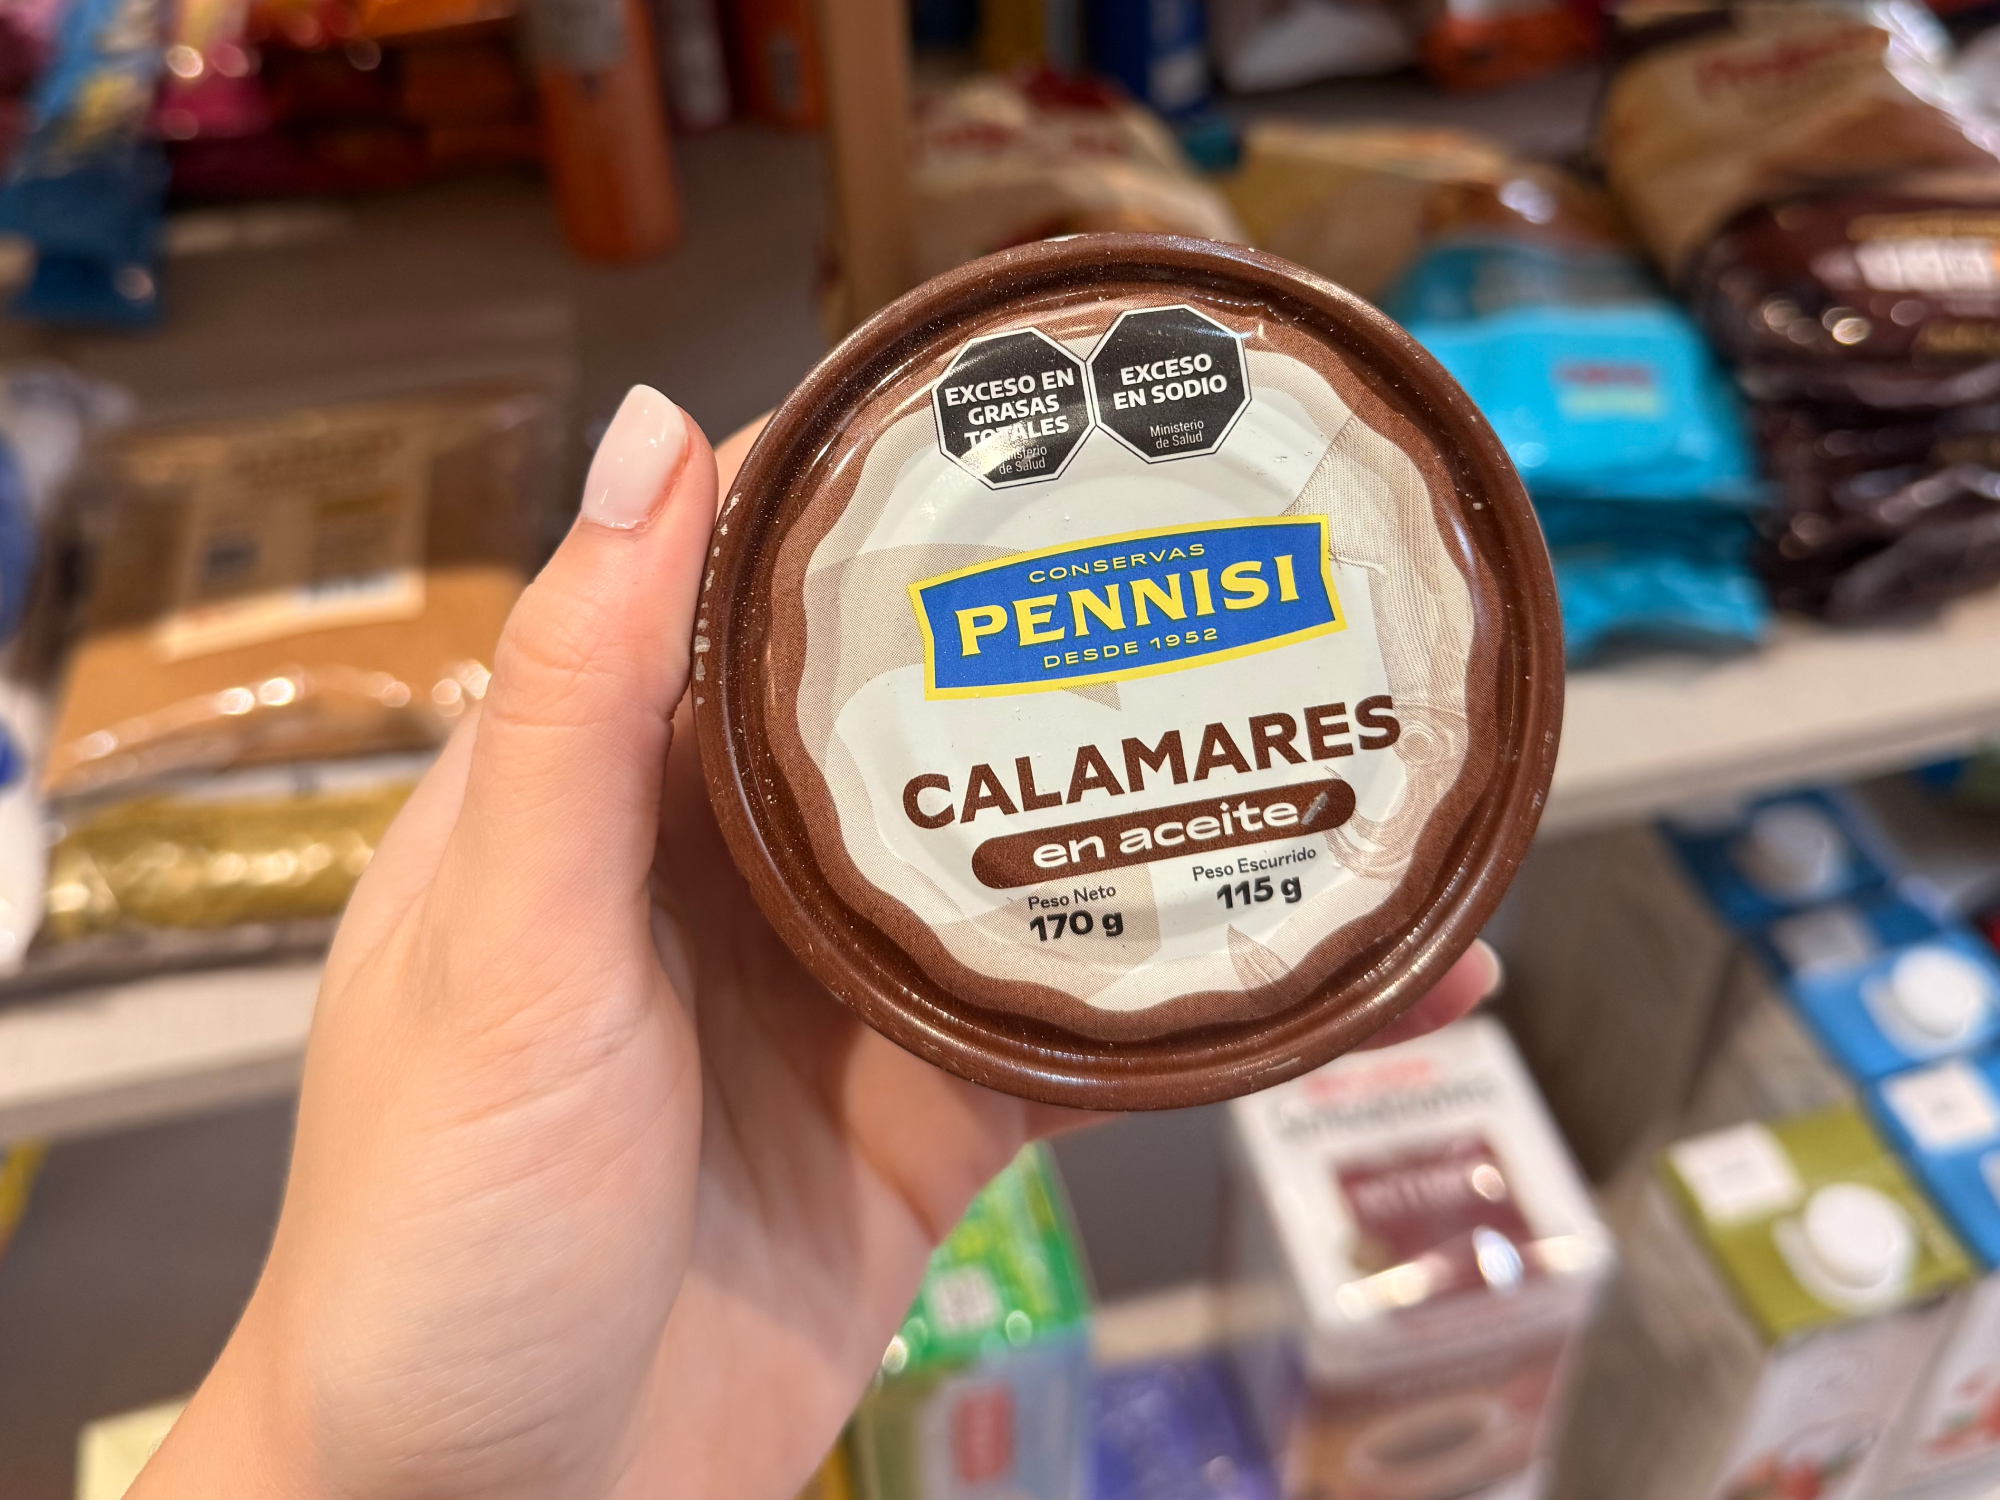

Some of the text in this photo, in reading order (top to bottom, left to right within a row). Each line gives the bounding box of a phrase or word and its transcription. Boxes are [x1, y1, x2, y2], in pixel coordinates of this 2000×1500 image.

[1120, 353, 1212, 386] EXCESO
[945, 368, 1074, 407] EXCESO EN
[1113, 375, 1227, 410] EN SODIO
[968, 394, 1060, 426] GRASAS
[1151, 420, 1204, 438] Ministerio
[1156, 430, 1202, 449] de Salud
[999, 457, 1046, 474] de Salud
[1028, 543, 1205, 584] CONSERVAS
[954, 554, 1300, 656] PENNISI
[1043, 627, 1219, 668] DESDE 1952
[902, 695, 1400, 830] CALAMARES
[1033, 800, 1298, 870] en aceite
[1192, 846, 1316, 882] Peso Escurrido
[1027, 883, 1116, 910] Peso Neto
[1216, 874, 1302, 910] 115 g
[1029, 910, 1124, 942] 170 g
